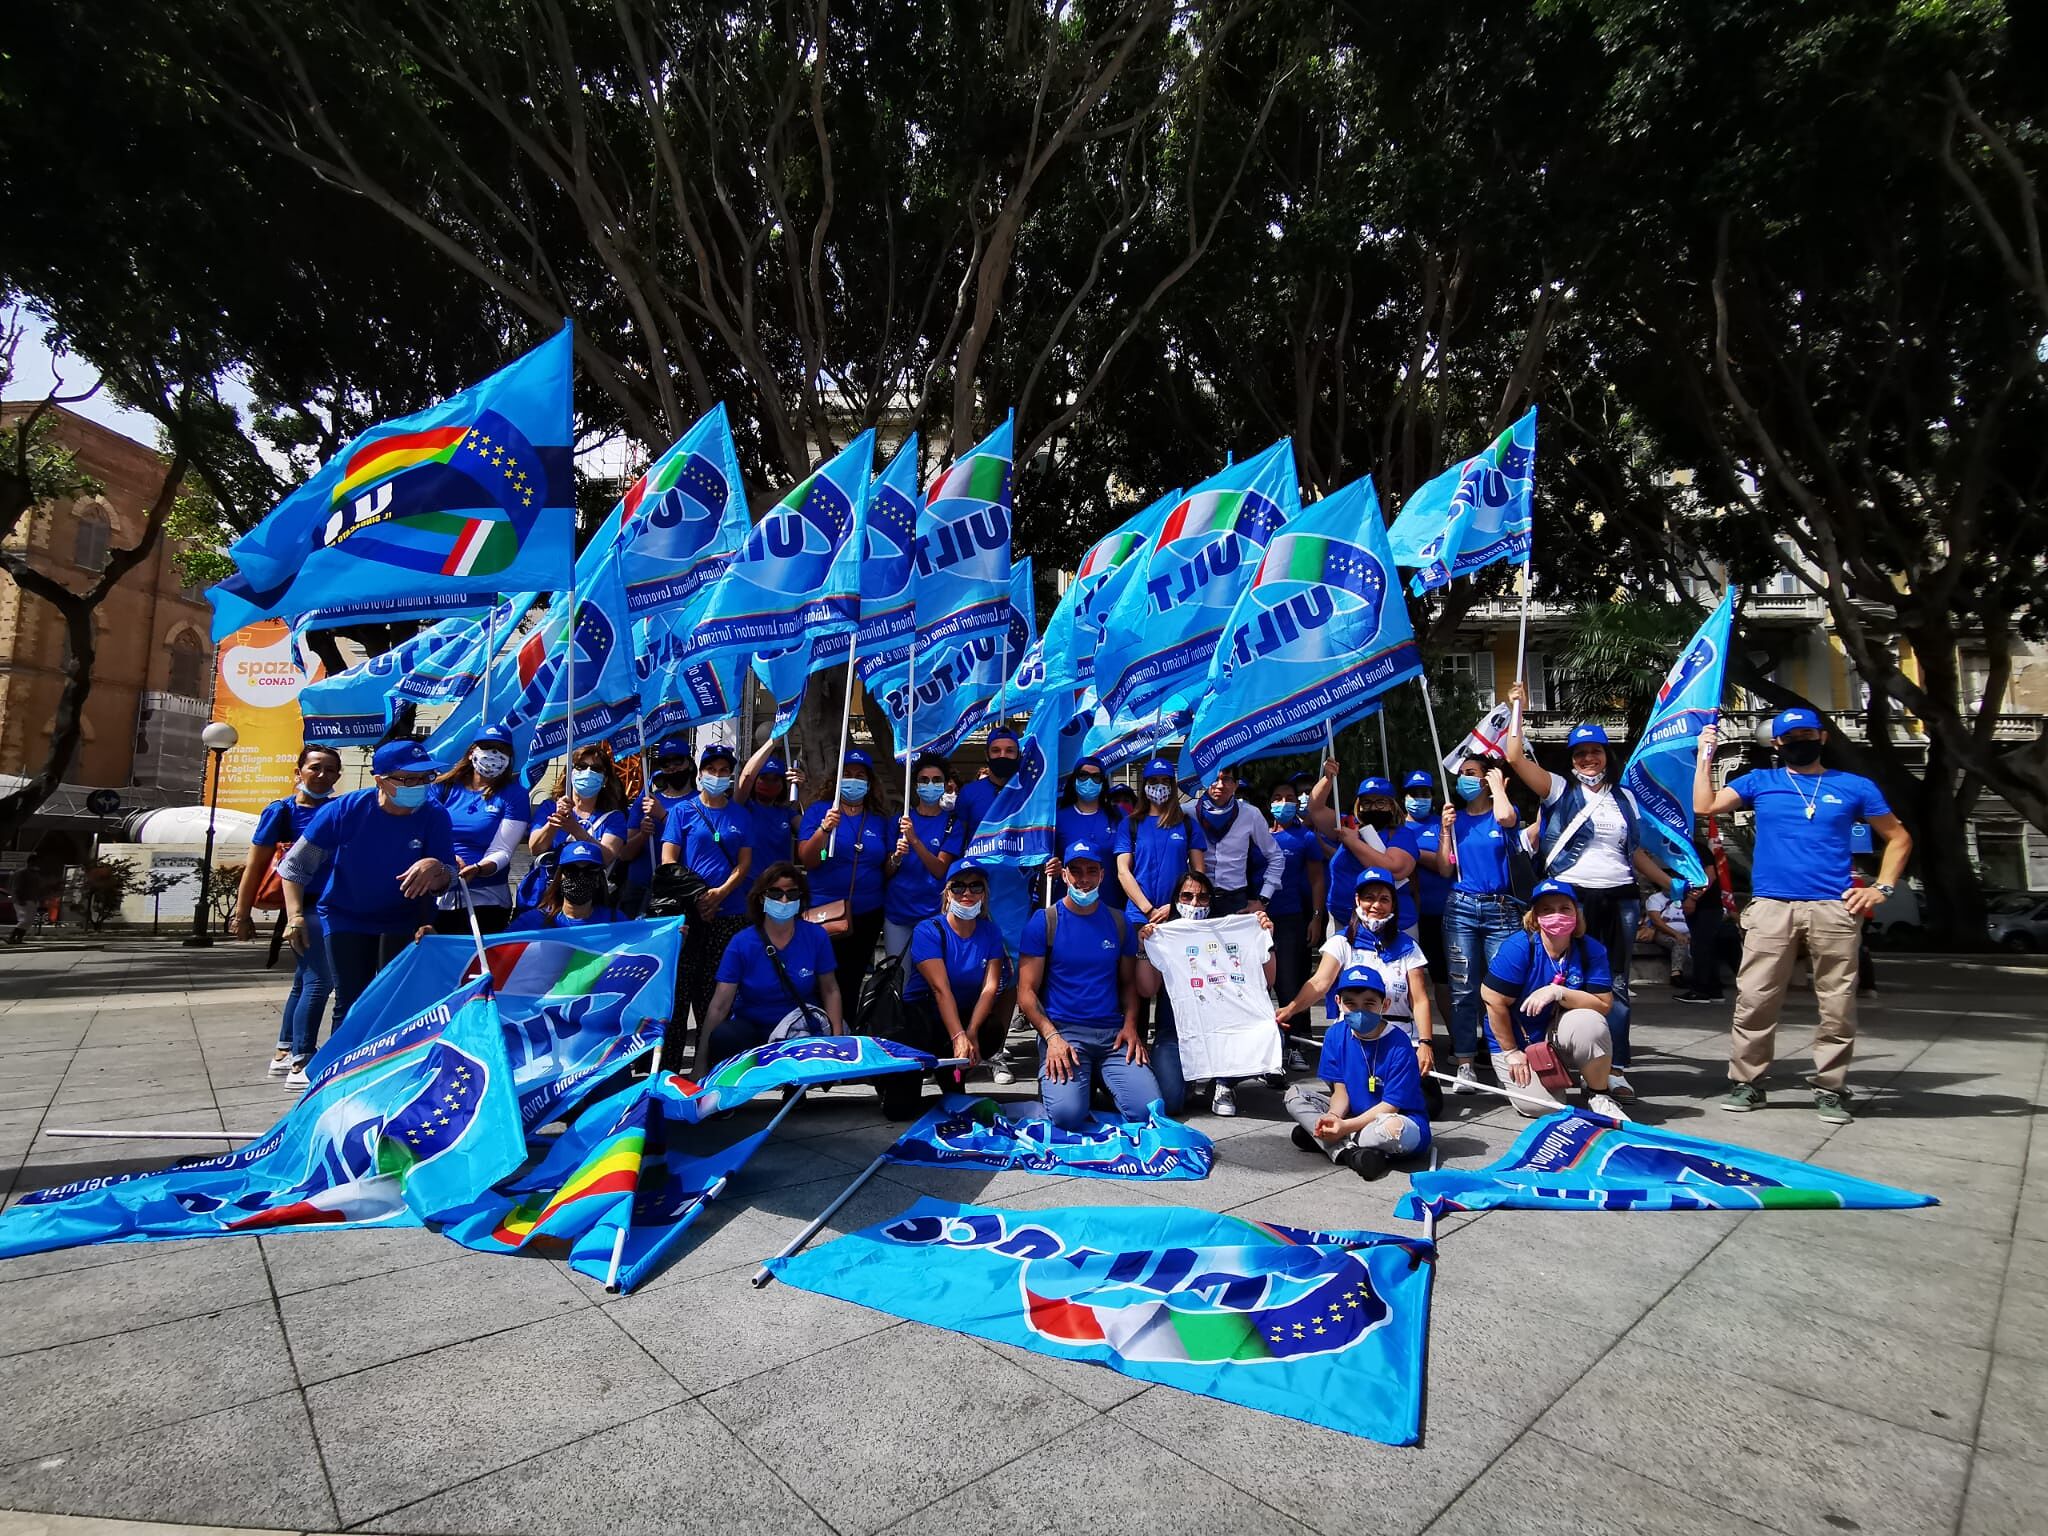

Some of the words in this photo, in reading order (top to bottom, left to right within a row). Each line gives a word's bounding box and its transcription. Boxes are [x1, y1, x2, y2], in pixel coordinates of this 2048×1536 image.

[259, 677, 295, 686] CONAD
[695, 680, 718, 707] Servizi
[275, 753, 299, 764] 2020
[226, 764, 262, 775] Cagliari
[1652, 797, 1686, 828] Turismo
[1530, 1131, 1575, 1165] Italiana
